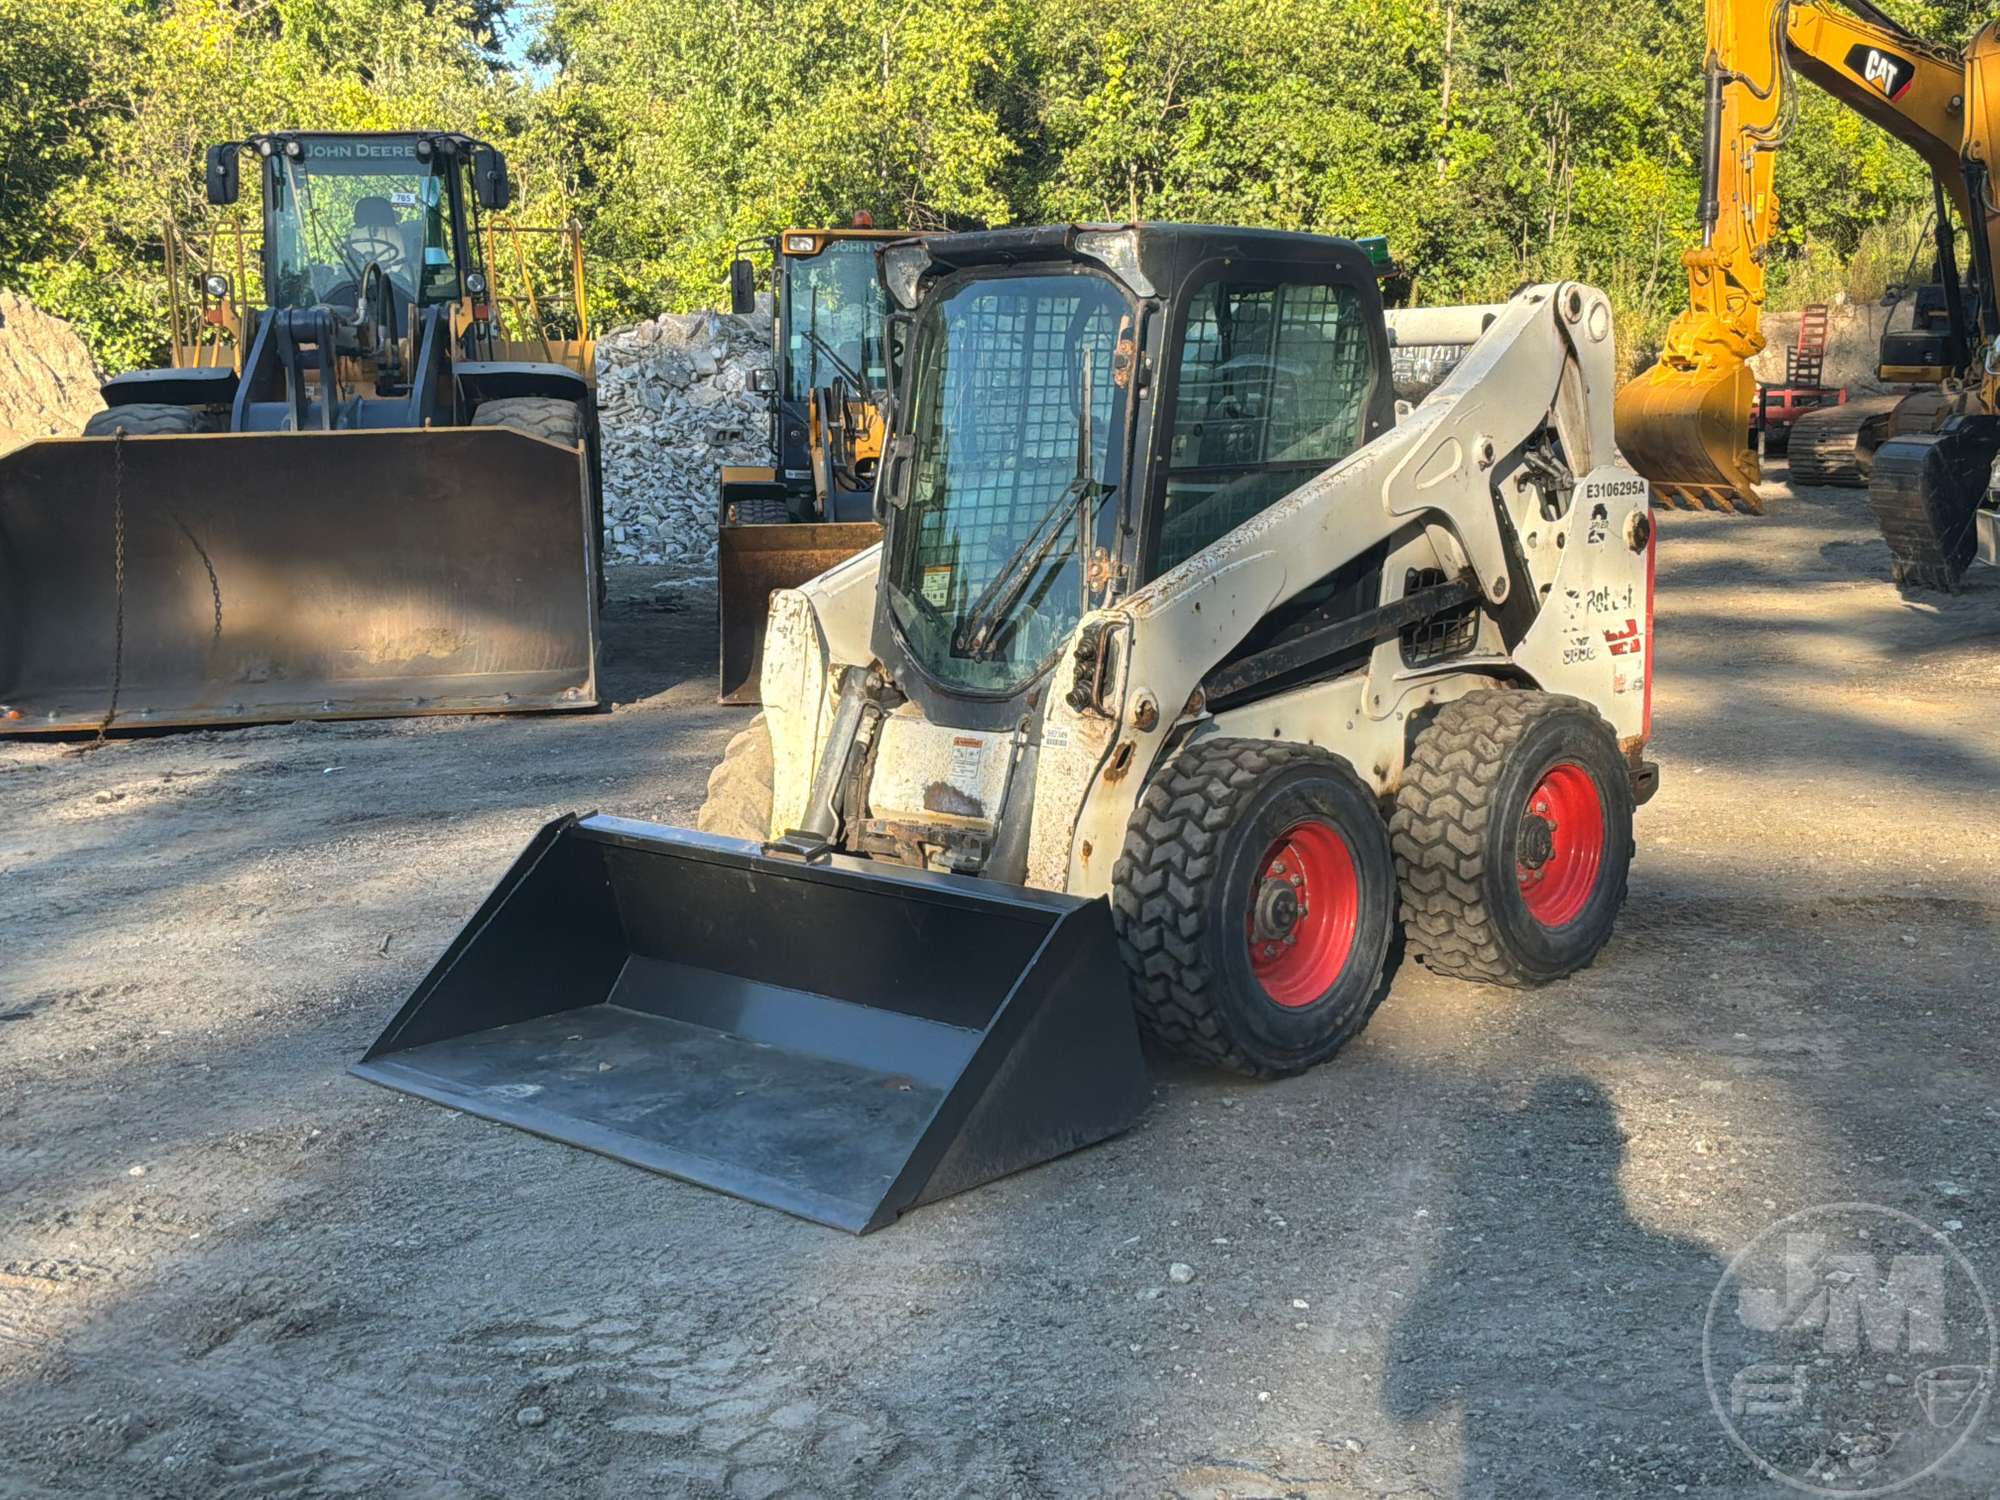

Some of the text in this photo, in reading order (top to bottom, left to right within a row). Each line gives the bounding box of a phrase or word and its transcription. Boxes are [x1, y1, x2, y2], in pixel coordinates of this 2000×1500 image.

[1865, 49, 1898, 96] CAT
[305, 143, 416, 158] JOHN DEERE
[1586, 480, 1646, 499] E3106295A
